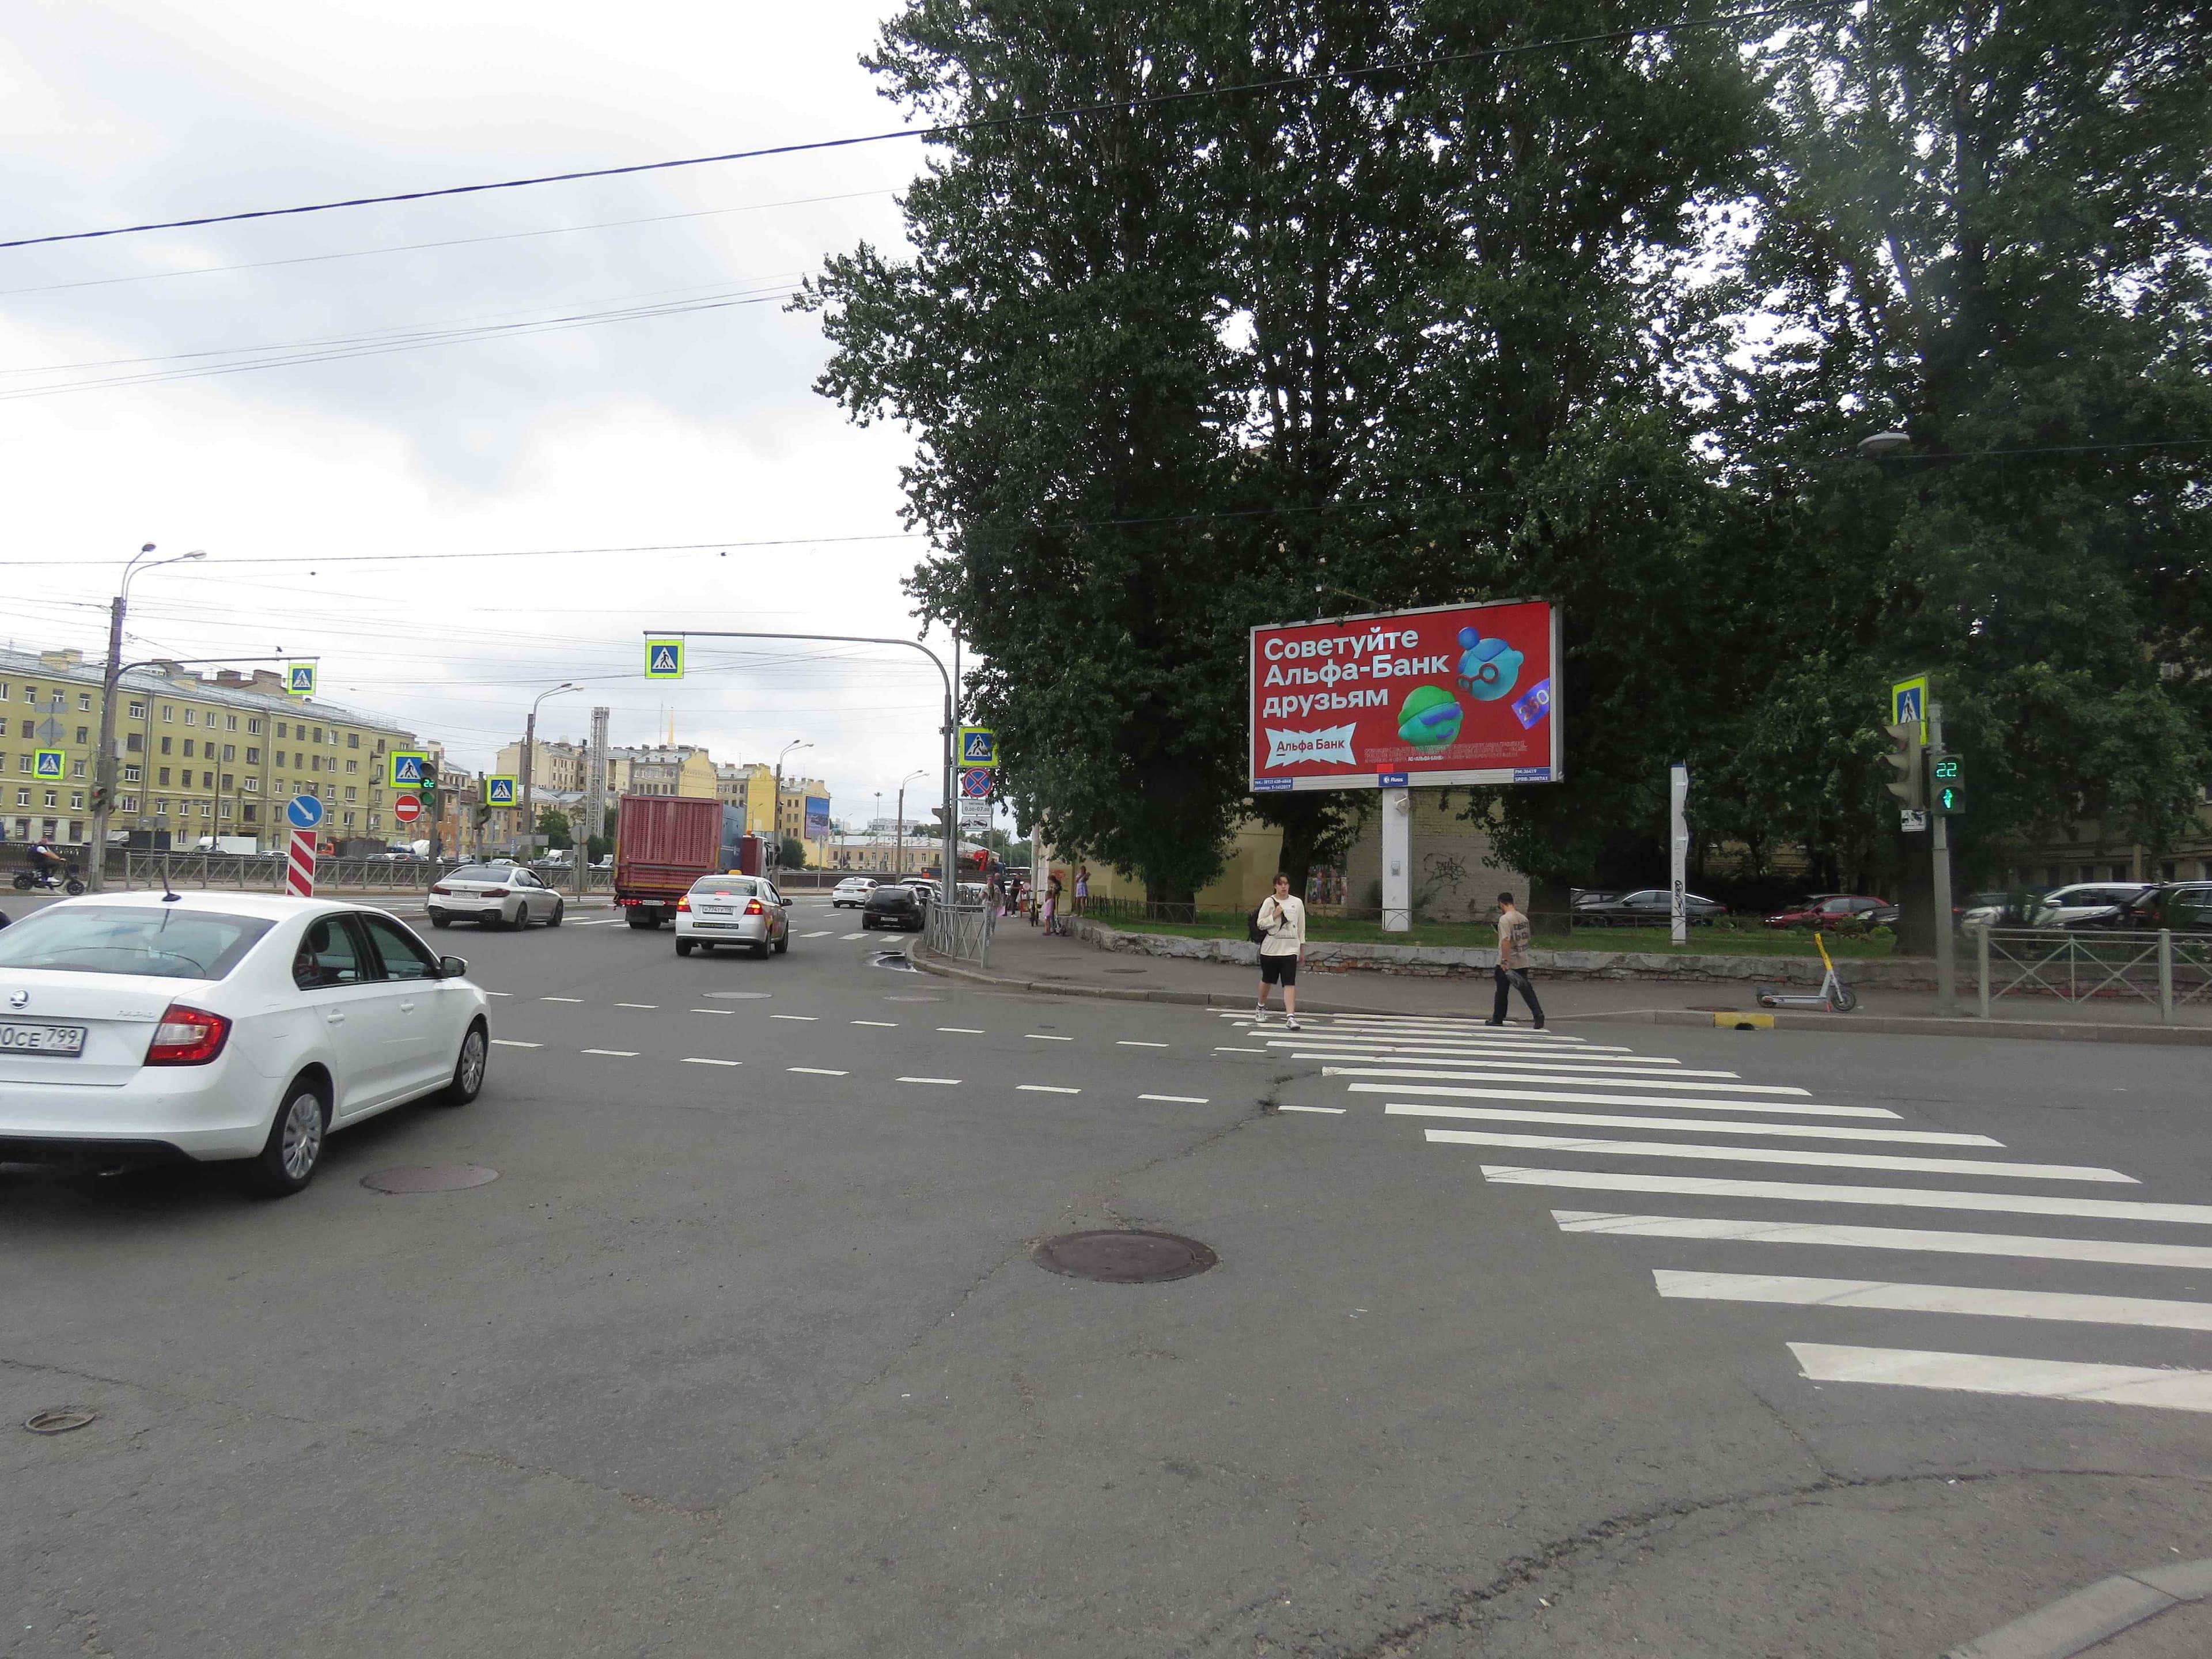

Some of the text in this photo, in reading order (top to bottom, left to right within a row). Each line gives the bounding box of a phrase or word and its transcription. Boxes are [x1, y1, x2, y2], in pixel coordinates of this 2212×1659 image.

[1264, 627, 1419, 661] Советуйте
[1263, 654, 1450, 688] Альфа-Банк
[1262, 688, 1388, 719] друзьям
[1519, 686, 1550, 721] 250
[1276, 738, 1345, 753] Альфа Банк
[1936, 762, 1957, 777] 22
[0, 1027, 78, 1047] 0СЕ 799
